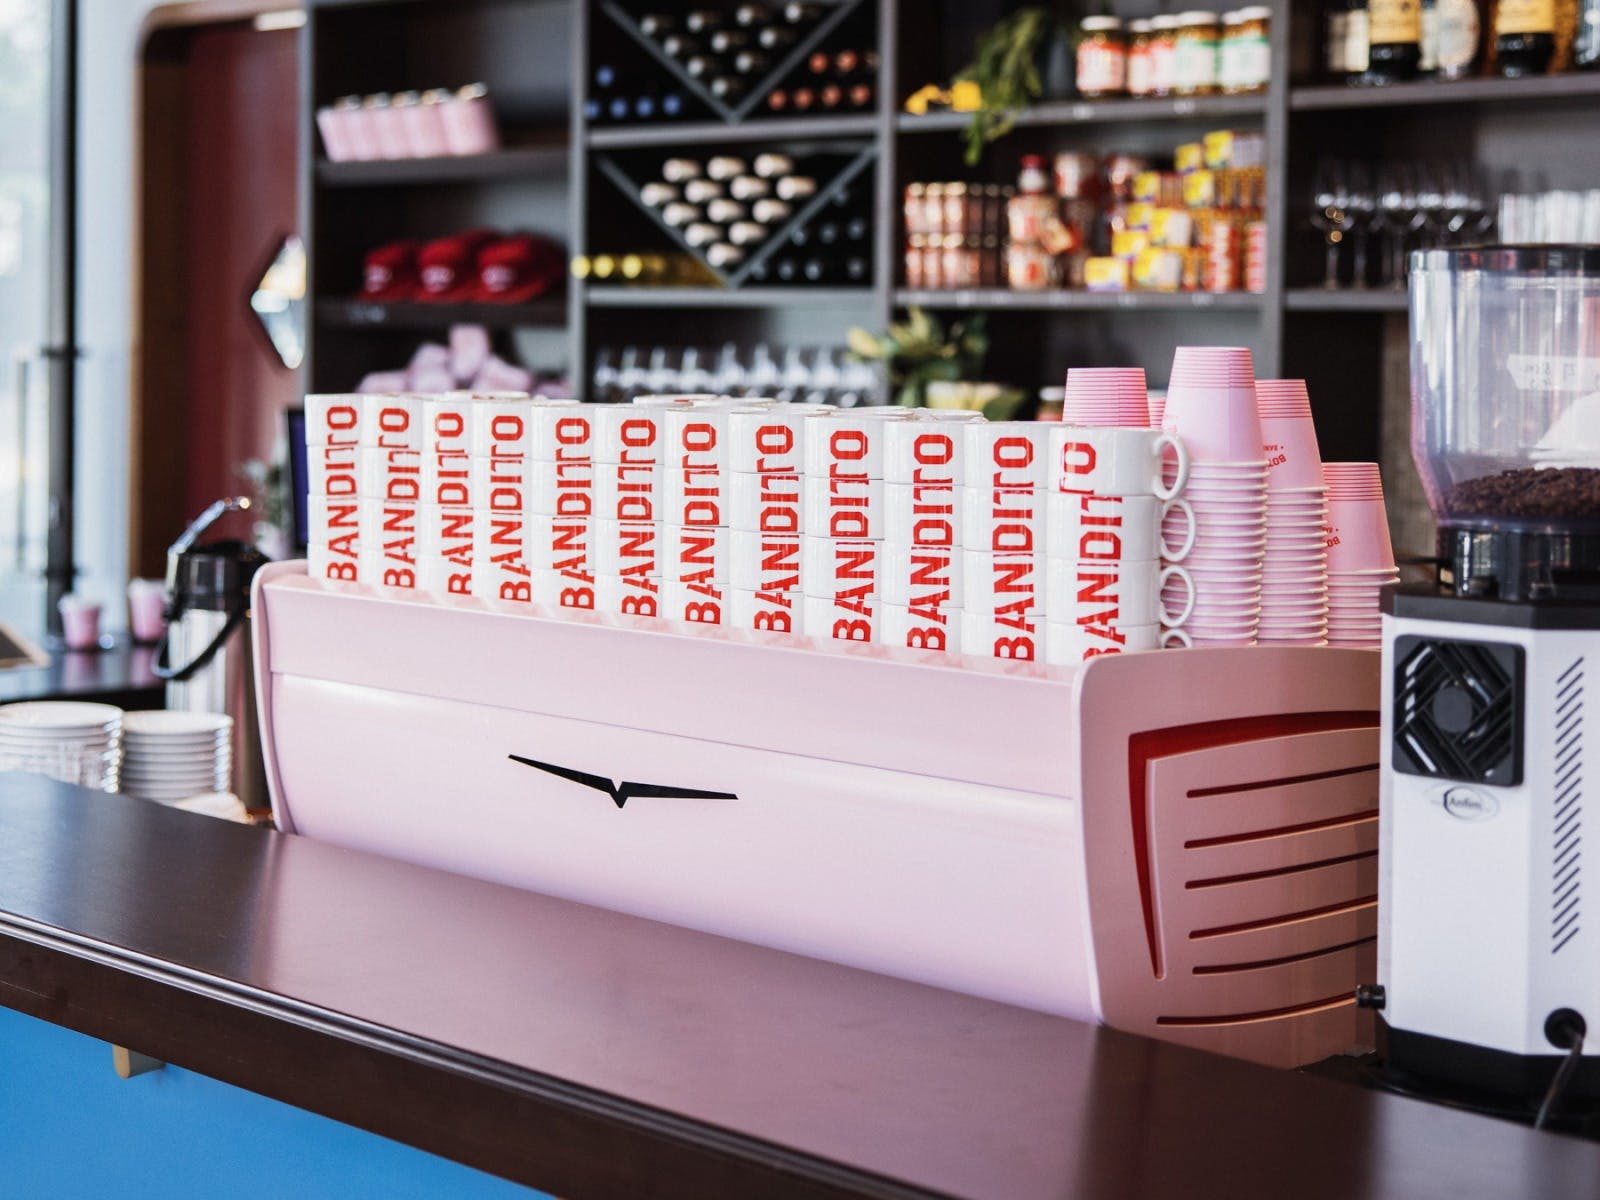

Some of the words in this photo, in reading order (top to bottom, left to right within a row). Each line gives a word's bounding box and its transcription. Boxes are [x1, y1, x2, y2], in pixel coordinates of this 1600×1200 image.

[325, 405, 360, 580] BANDITO
[378, 407, 420, 587] BANDITO
[490, 415, 531, 601] BANDITO
[552, 418, 595, 609] BANDITO
[617, 419, 658, 616] BANDITO
[679, 423, 722, 623] BANDITO
[753, 425, 800, 633] BANDITO
[829, 430, 875, 642] BANDITO
[906, 434, 954, 653] BANDITO
[992, 436, 1036, 663] BANDITO
